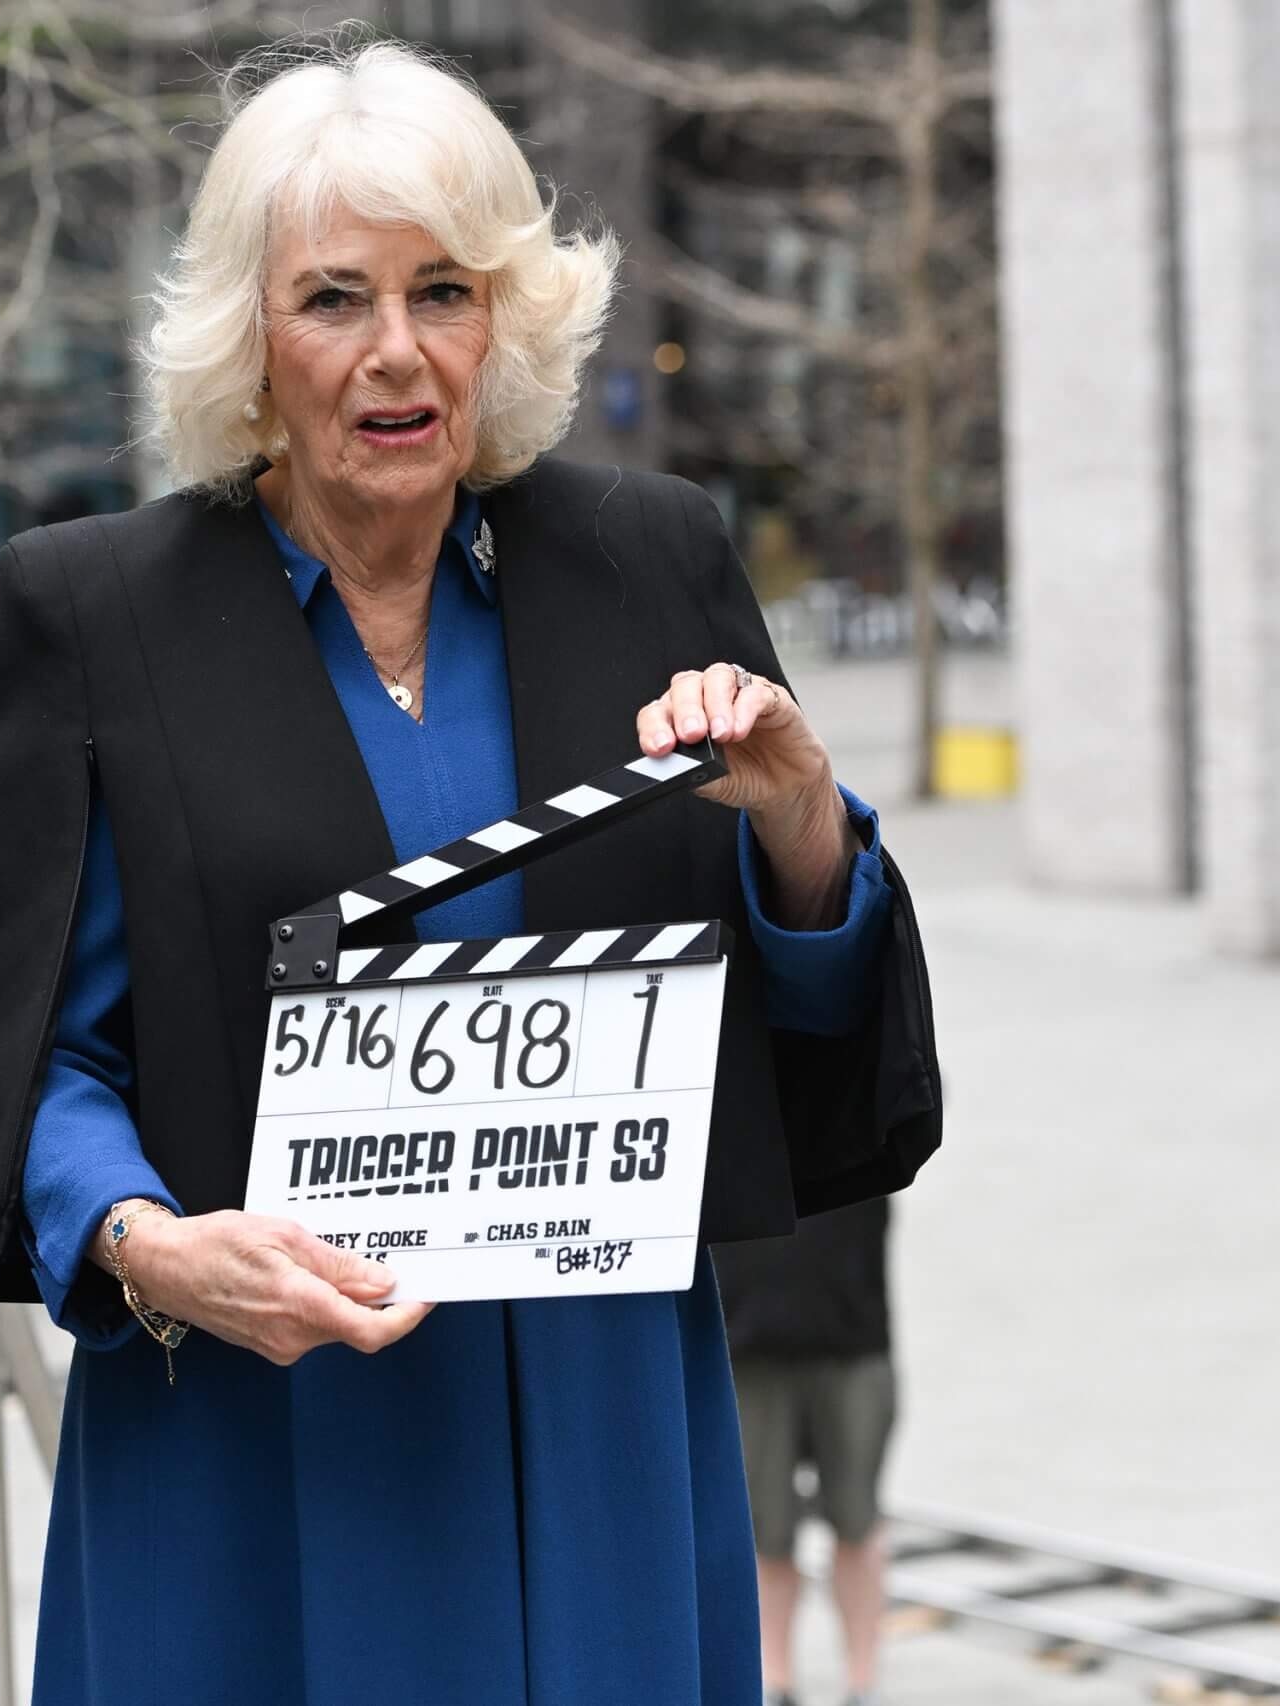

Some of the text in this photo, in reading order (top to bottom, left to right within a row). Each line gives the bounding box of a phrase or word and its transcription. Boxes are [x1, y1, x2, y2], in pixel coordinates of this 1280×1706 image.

[483, 985, 504, 997] SLATE
[646, 973, 664, 985] TAKE
[325, 996, 347, 1009] SCENE
[274, 1004, 395, 1077] 5/16
[410, 998, 571, 1095] 698
[633, 985, 660, 1090] 1
[287, 1117, 670, 1201] TRIGGER POINT S3
[367, 1229, 429, 1249] COOKE
[486, 1221, 539, 1242] CHAS
[543, 1218, 592, 1239] BAIN
[556, 1239, 633, 1275] B#137
